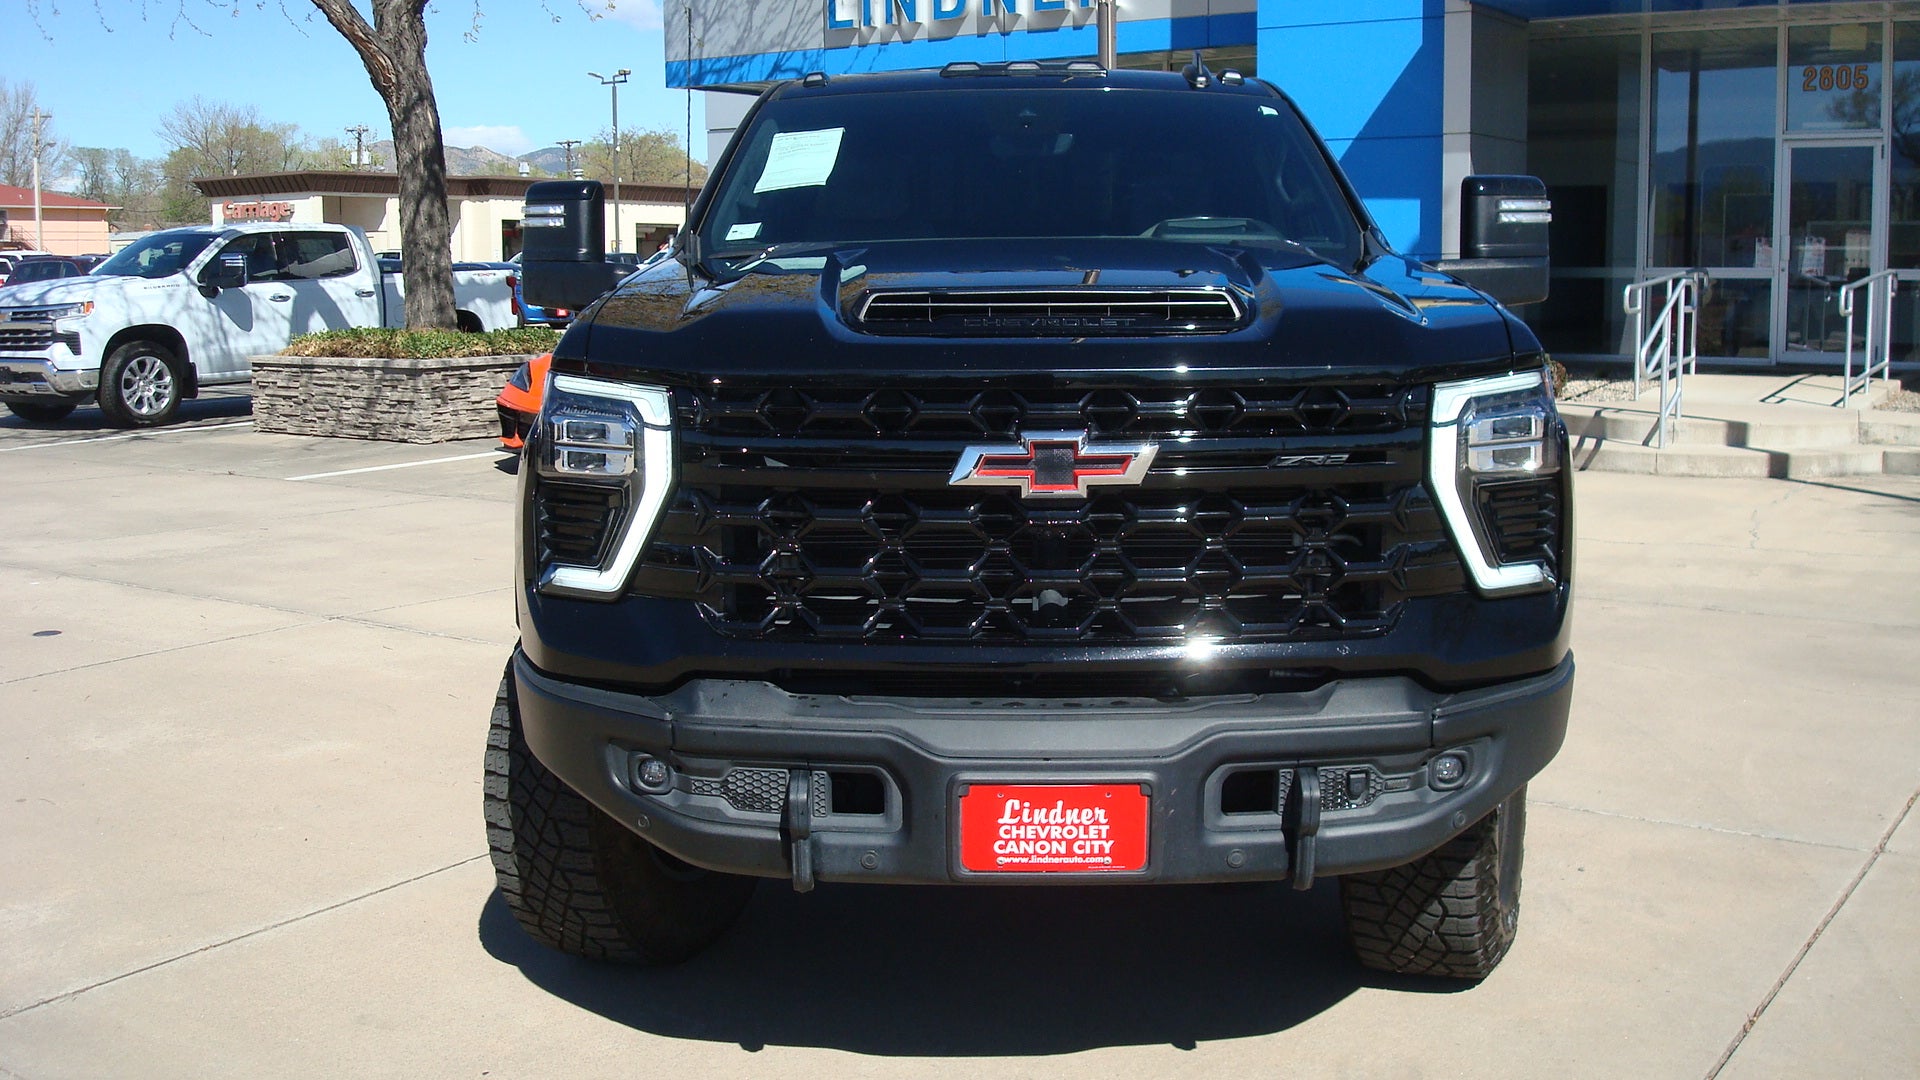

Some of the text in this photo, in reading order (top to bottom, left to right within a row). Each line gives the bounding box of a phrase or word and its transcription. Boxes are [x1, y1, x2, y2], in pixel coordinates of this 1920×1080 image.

[827, 0, 1092, 30] LIND
[1803, 64, 1869, 92] 2805
[222, 199, 291, 222] Carriage
[964, 317, 1137, 328] CHEVROLET
[1274, 453, 1350, 467] ZR2
[997, 798, 1109, 826] Lindner
[998, 824, 1110, 840] CHEVROLET
[992, 839, 1115, 855] CANON CITY
[1003, 854, 1104, 865] www.lindnerauto.com
